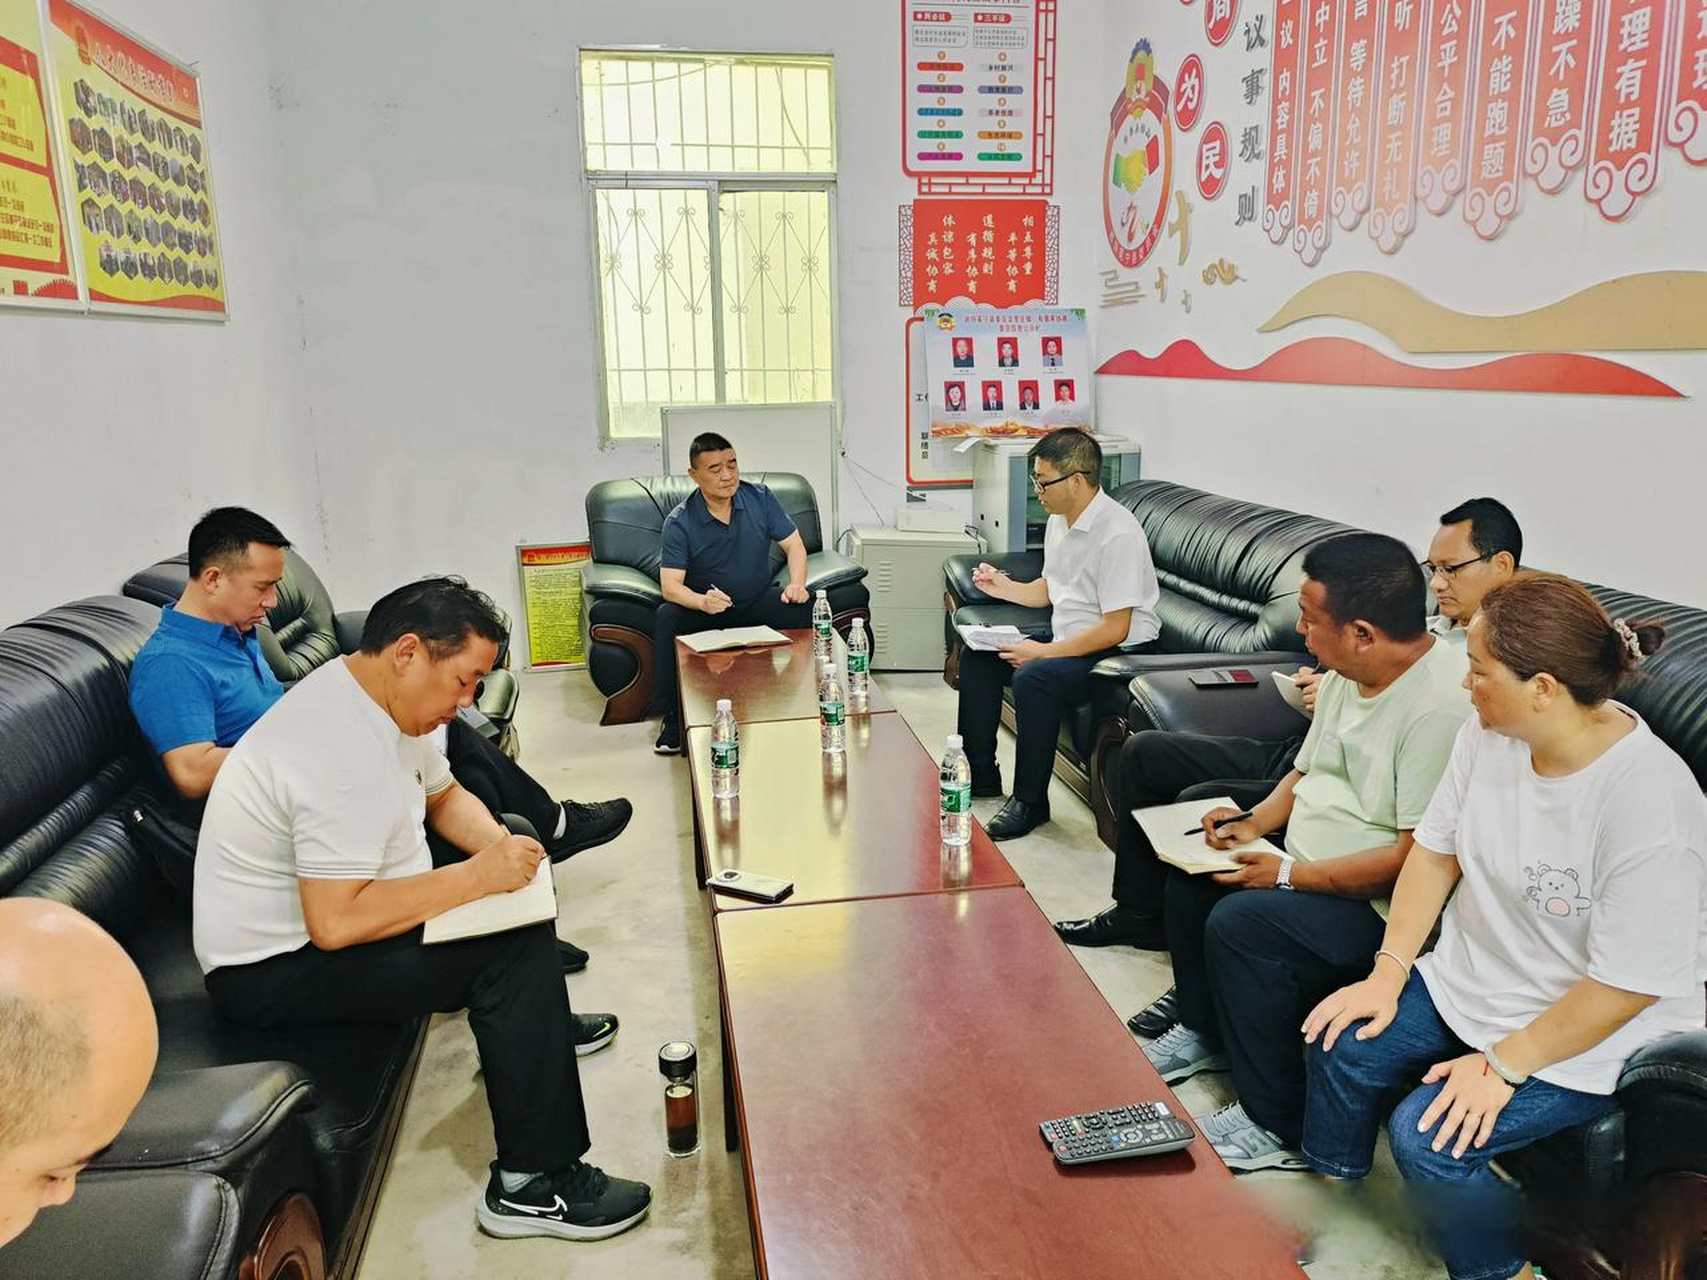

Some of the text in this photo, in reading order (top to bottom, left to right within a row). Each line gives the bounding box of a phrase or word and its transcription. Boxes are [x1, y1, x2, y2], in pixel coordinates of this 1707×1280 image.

[1176, 69, 1200, 114] 为
[1430, 0, 1463, 157] 公平合理
[1480, 10, 1518, 181] 不能跑题
[1608, 0, 1652, 153] 理有据
[1234, 14, 1266, 226] 议事规则
[1202, 139, 1225, 183] 民
[926, 232, 940, 294] 真诚协商
[942, 214, 956, 276] 体谅包容
[966, 232, 979, 294] 有序协商
[982, 213, 996, 275] 遵循规则
[1007, 232, 1019, 294] 平等协商
[1022, 214, 1035, 276] 相互尊重
